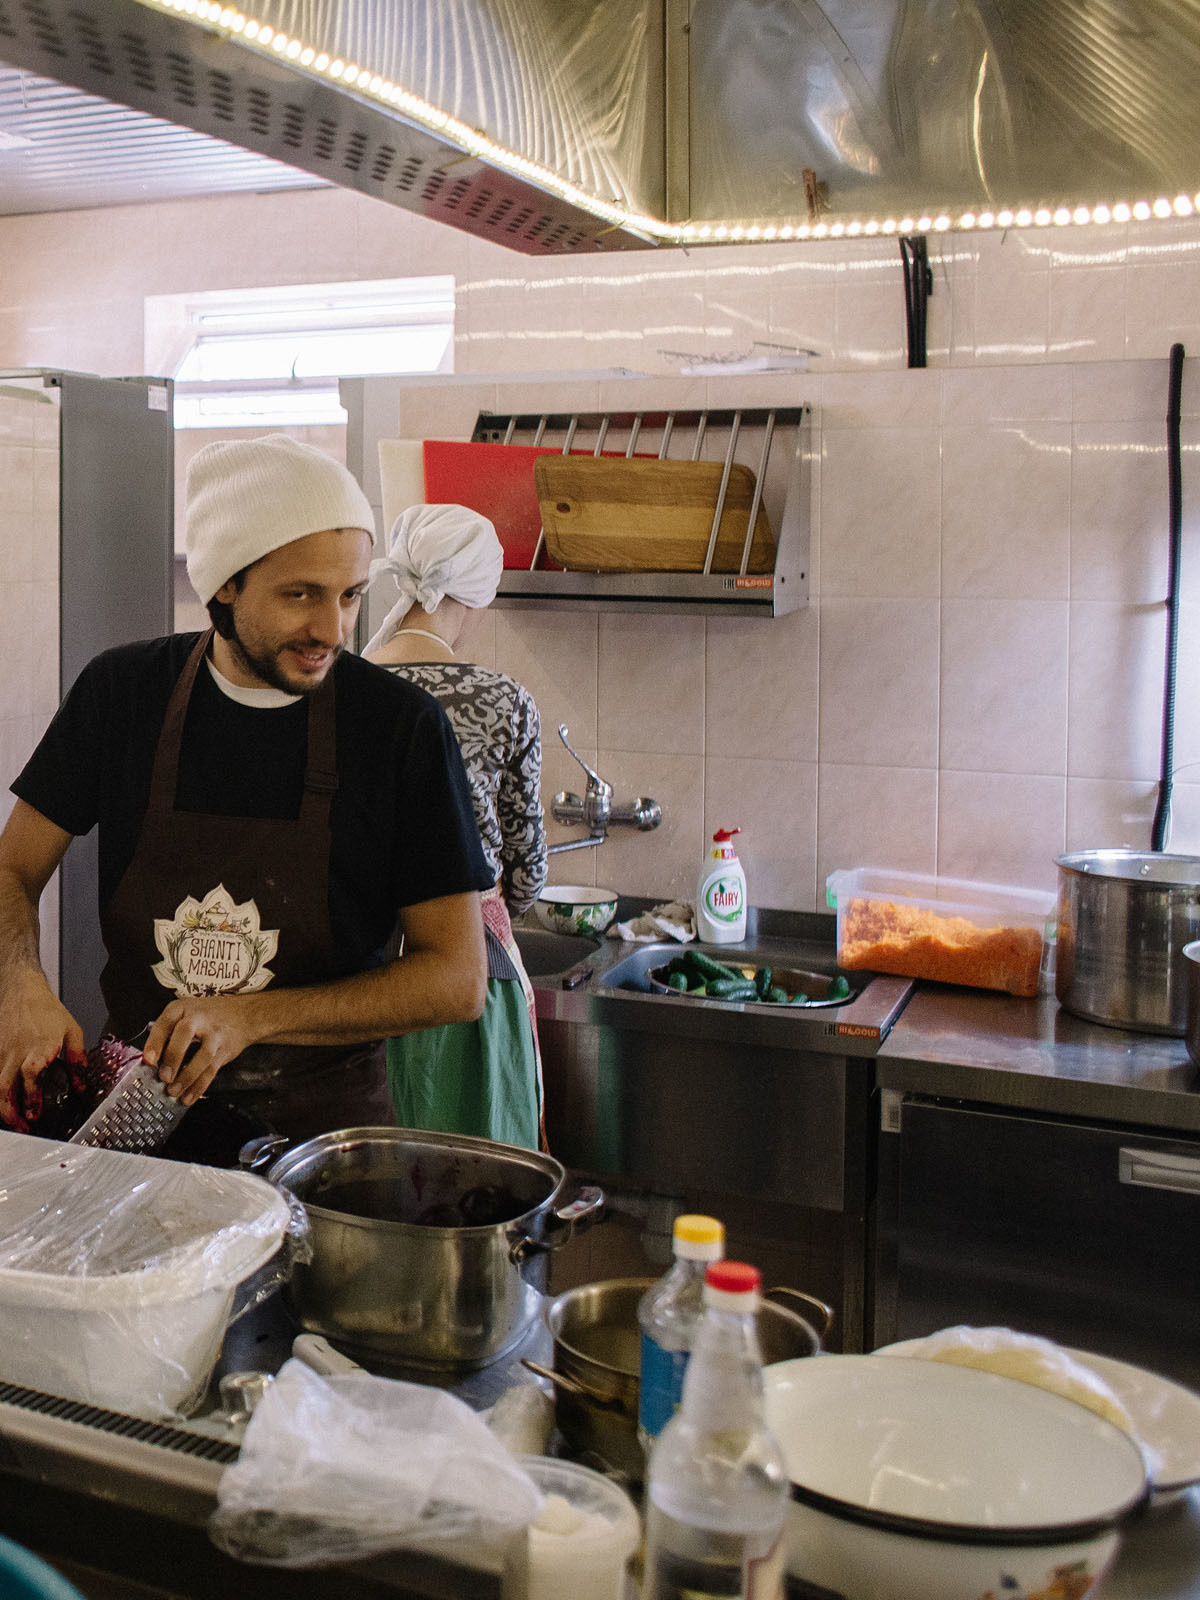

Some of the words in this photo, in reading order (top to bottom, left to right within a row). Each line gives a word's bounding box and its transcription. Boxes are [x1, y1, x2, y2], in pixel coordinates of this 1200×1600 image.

[714, 892, 739, 906] FAIRY
[190, 937, 242, 961] SHANTI
[188, 959, 241, 979] MASALA
